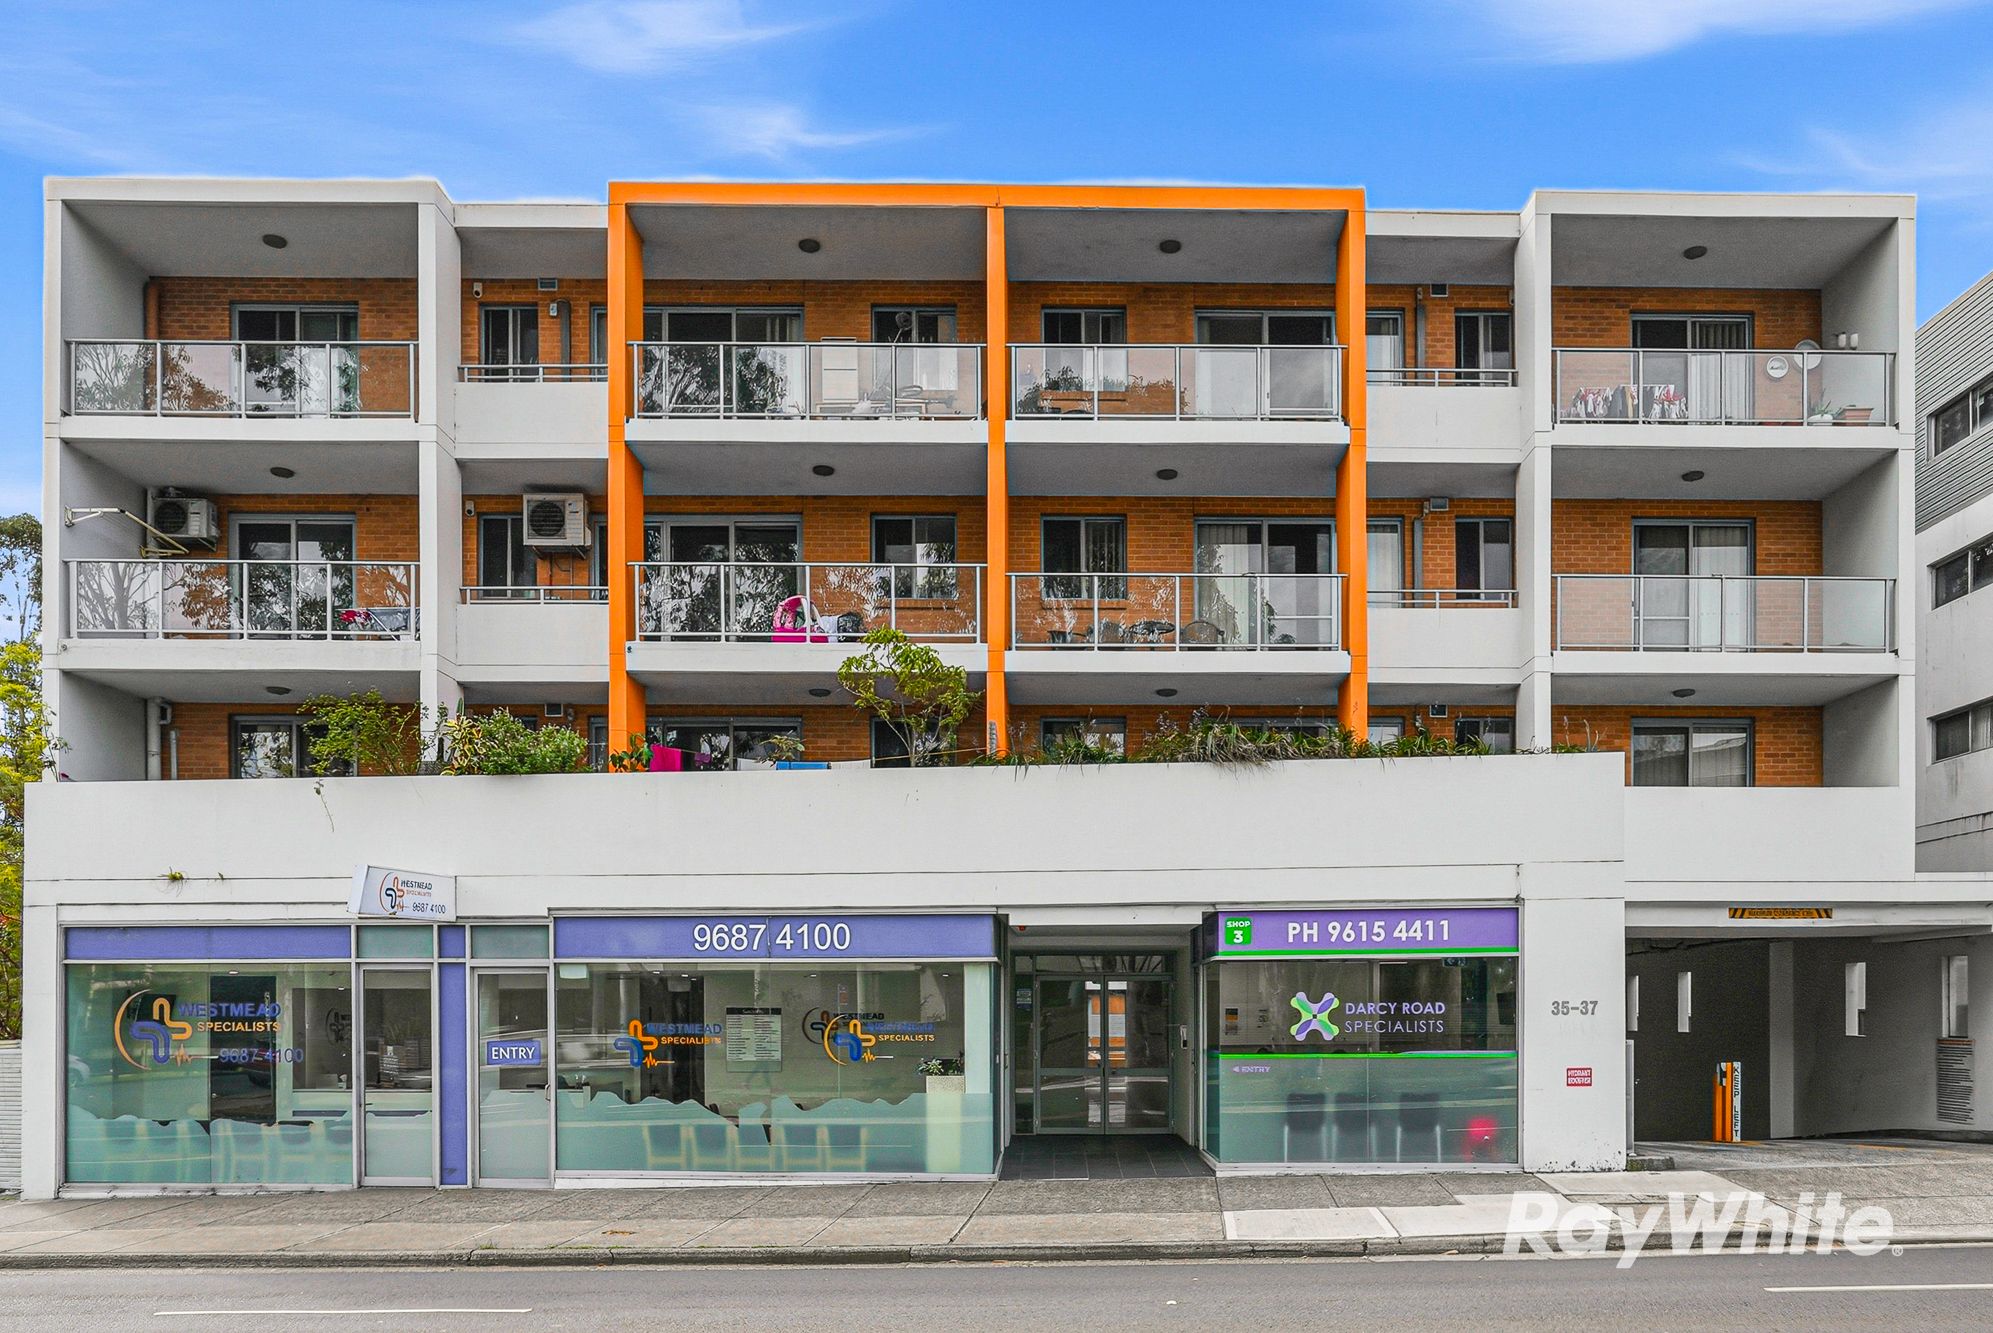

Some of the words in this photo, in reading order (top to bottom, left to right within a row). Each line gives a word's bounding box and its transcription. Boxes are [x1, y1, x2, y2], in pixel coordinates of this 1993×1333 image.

[412, 902, 429, 912] 9687
[430, 904, 446, 914] 4100
[1226, 920, 1251, 928] SHOP
[693, 923, 767, 951] 9687
[775, 923, 851, 950] 4100
[1233, 930, 1244, 943] 3
[1287, 922, 1318, 943] PH
[1327, 921, 1385, 942] 9615
[1392, 920, 1449, 941] 4411
[179, 1003, 281, 1017] WESTMEAD
[1345, 1002, 1397, 1015] DARCY
[1402, 1002, 1445, 1015] ROAD
[1551, 1000, 1598, 1015] 35-37
[197, 1022, 280, 1032] SPECIALISTS
[1344, 1020, 1444, 1033] SPECIALISTS
[878, 1034, 935, 1042] SPECIALISTS
[219, 1048, 262, 1062] 9687
[264, 1048, 304, 1062] 4100
[491, 1046, 535, 1059] ENTRY
